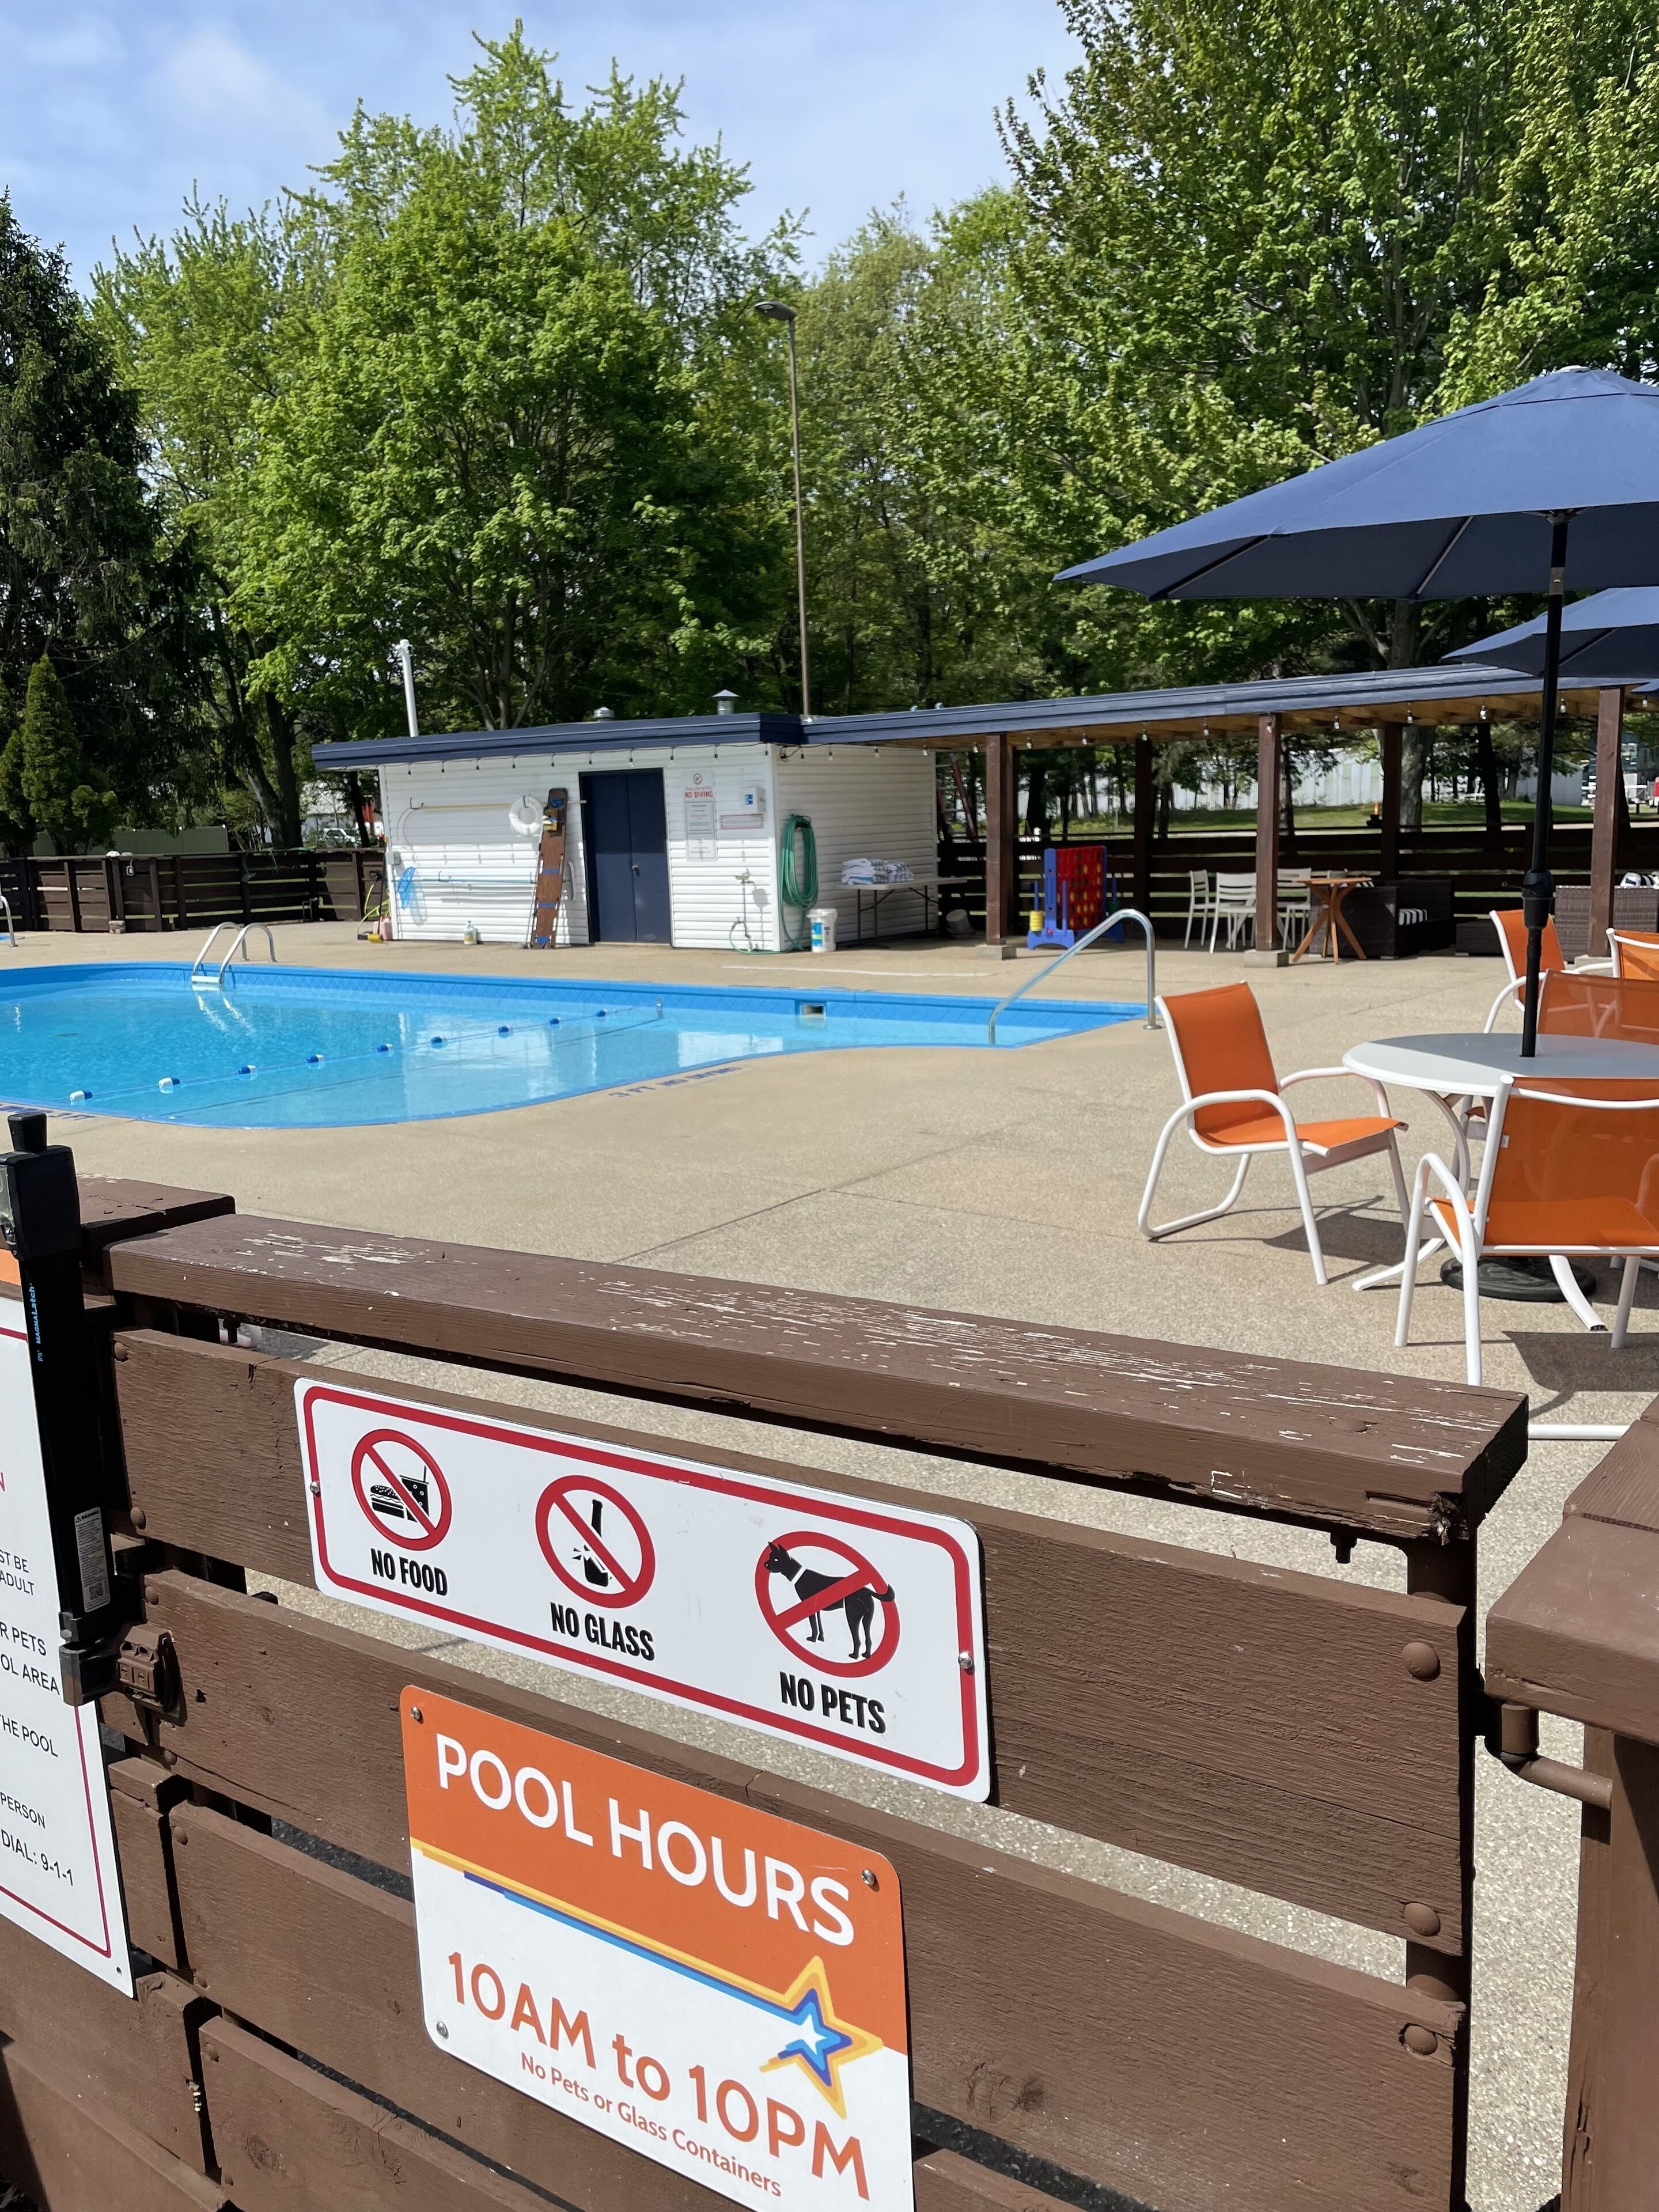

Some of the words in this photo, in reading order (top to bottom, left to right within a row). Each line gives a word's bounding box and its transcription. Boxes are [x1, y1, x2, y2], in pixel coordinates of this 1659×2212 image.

[0, 1570, 35, 1595] ADULT
[14, 1555, 29, 1573] BE
[370, 1547, 396, 1581] NO
[399, 1556, 448, 1596] FOOD
[12, 1626, 47, 1656] PETS
[550, 1602, 579, 1638] NO
[585, 1613, 656, 1661] GLASS
[22, 1664, 60, 1695] AREA
[779, 1671, 815, 1711] NO
[821, 1683, 887, 1734] PETS
[0, 1714, 20, 1737] HE
[22, 1725, 59, 1758] POOL
[0, 1791, 46, 1829] PERSON
[1, 1828, 37, 1865] DIAL:
[40, 1853, 73, 1887] 9-1-1
[436, 1733, 594, 1847] POOL
[608, 1797, 855, 1946] HOURS
[448, 1951, 597, 2070] 10AM
[612, 2033, 672, 2101] to
[688, 2065, 870, 2202] 10PM
[521, 2052, 547, 2080] No
[551, 2067, 589, 2102] Pets
[593, 2094, 613, 2113] or
[618, 2102, 667, 2141] Glass
[672, 2129, 782, 2198] Containers
